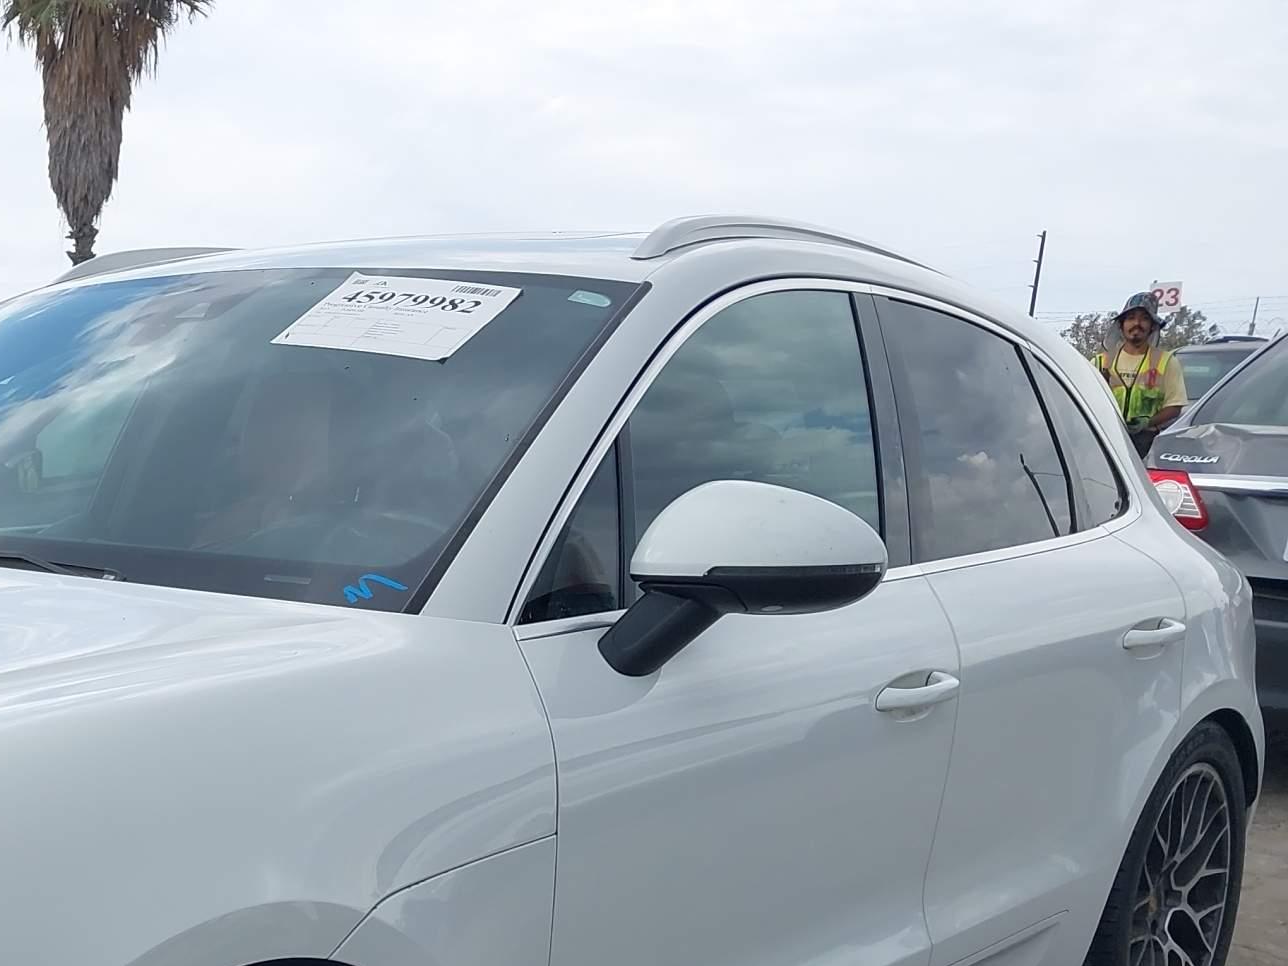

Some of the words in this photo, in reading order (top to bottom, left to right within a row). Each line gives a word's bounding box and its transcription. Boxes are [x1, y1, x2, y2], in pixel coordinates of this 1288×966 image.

[342, 289, 482, 314] 45979982
[1151, 287, 1180, 308] 23
[1159, 452, 1220, 464] COROLLA
